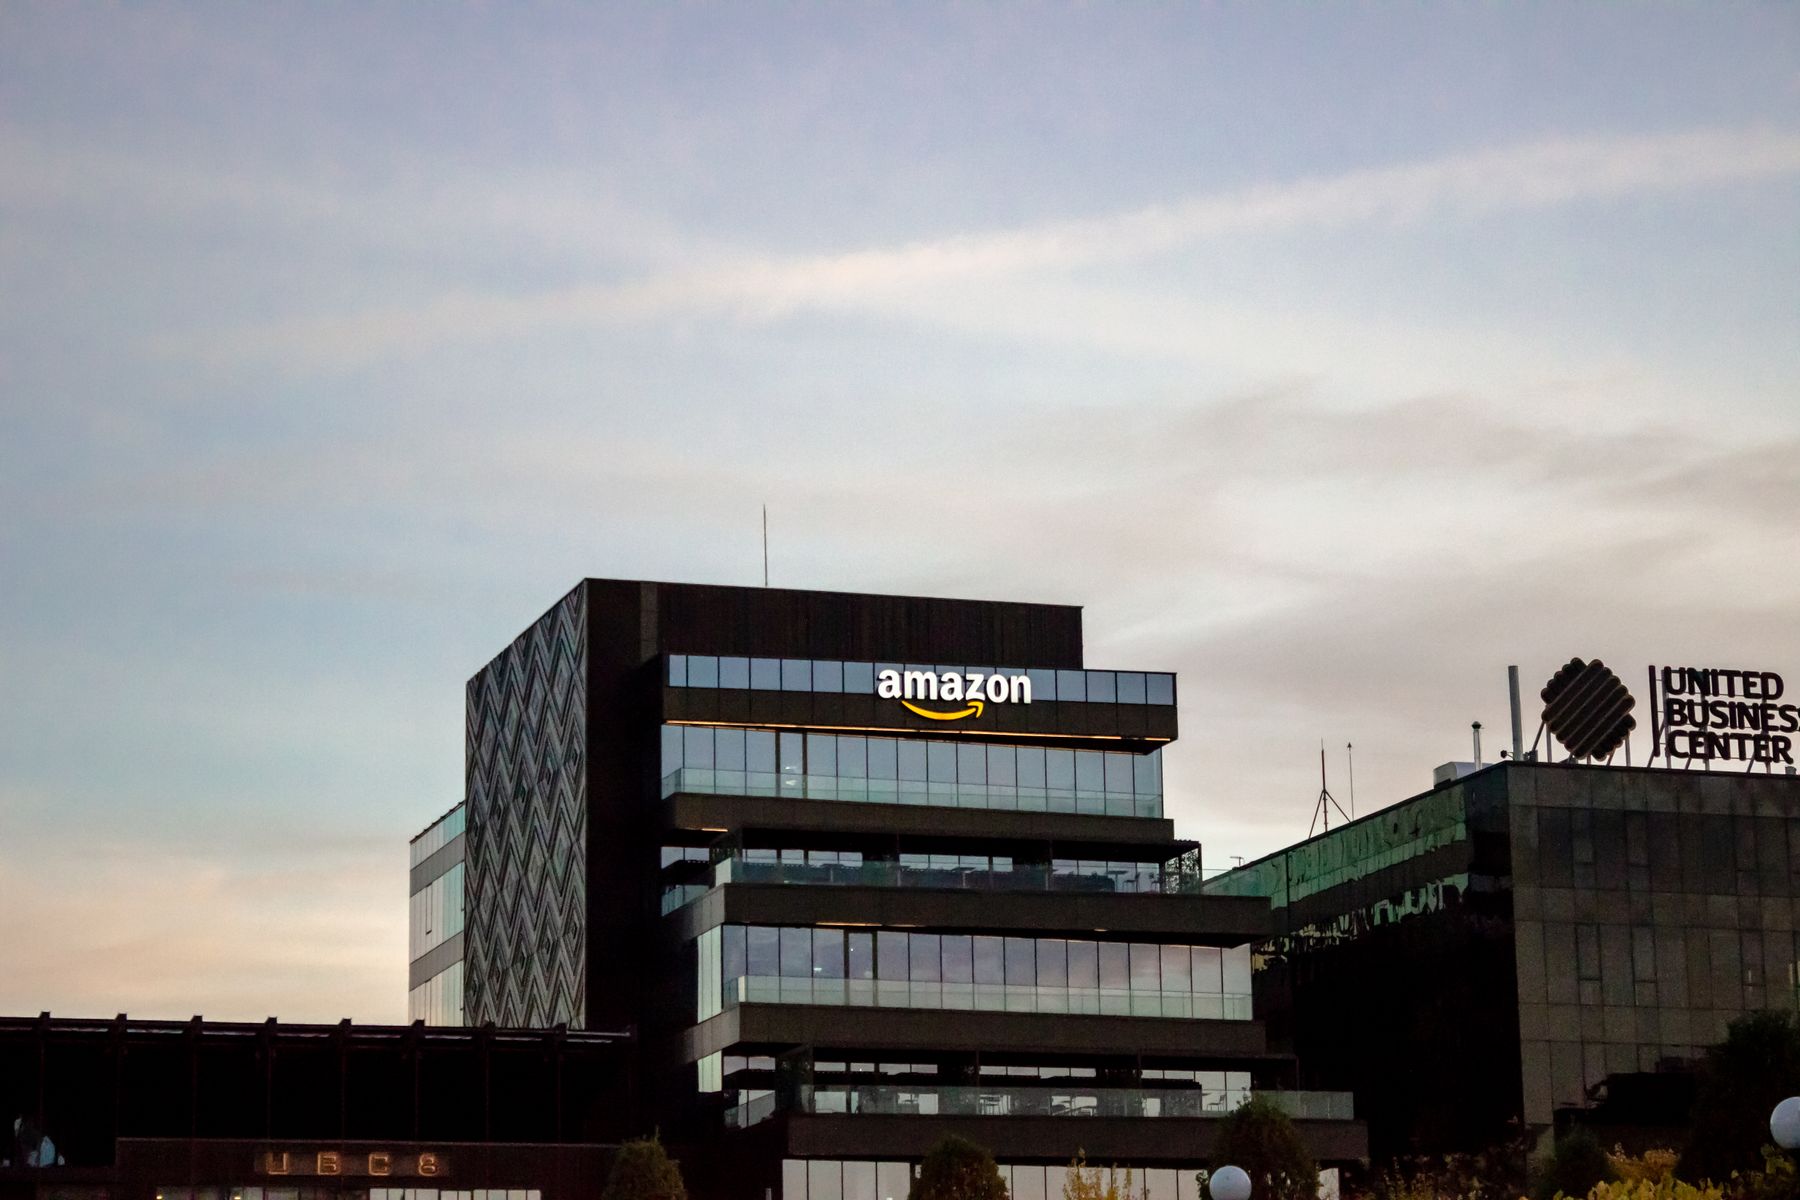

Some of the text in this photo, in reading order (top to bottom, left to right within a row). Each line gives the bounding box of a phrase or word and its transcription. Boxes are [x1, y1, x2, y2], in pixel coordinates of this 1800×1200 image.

[877, 669, 1032, 704] amazon
[1664, 666, 1784, 700] UNITED
[1667, 698, 1800, 732] BUSINES
[1668, 730, 1794, 764] CENTER
